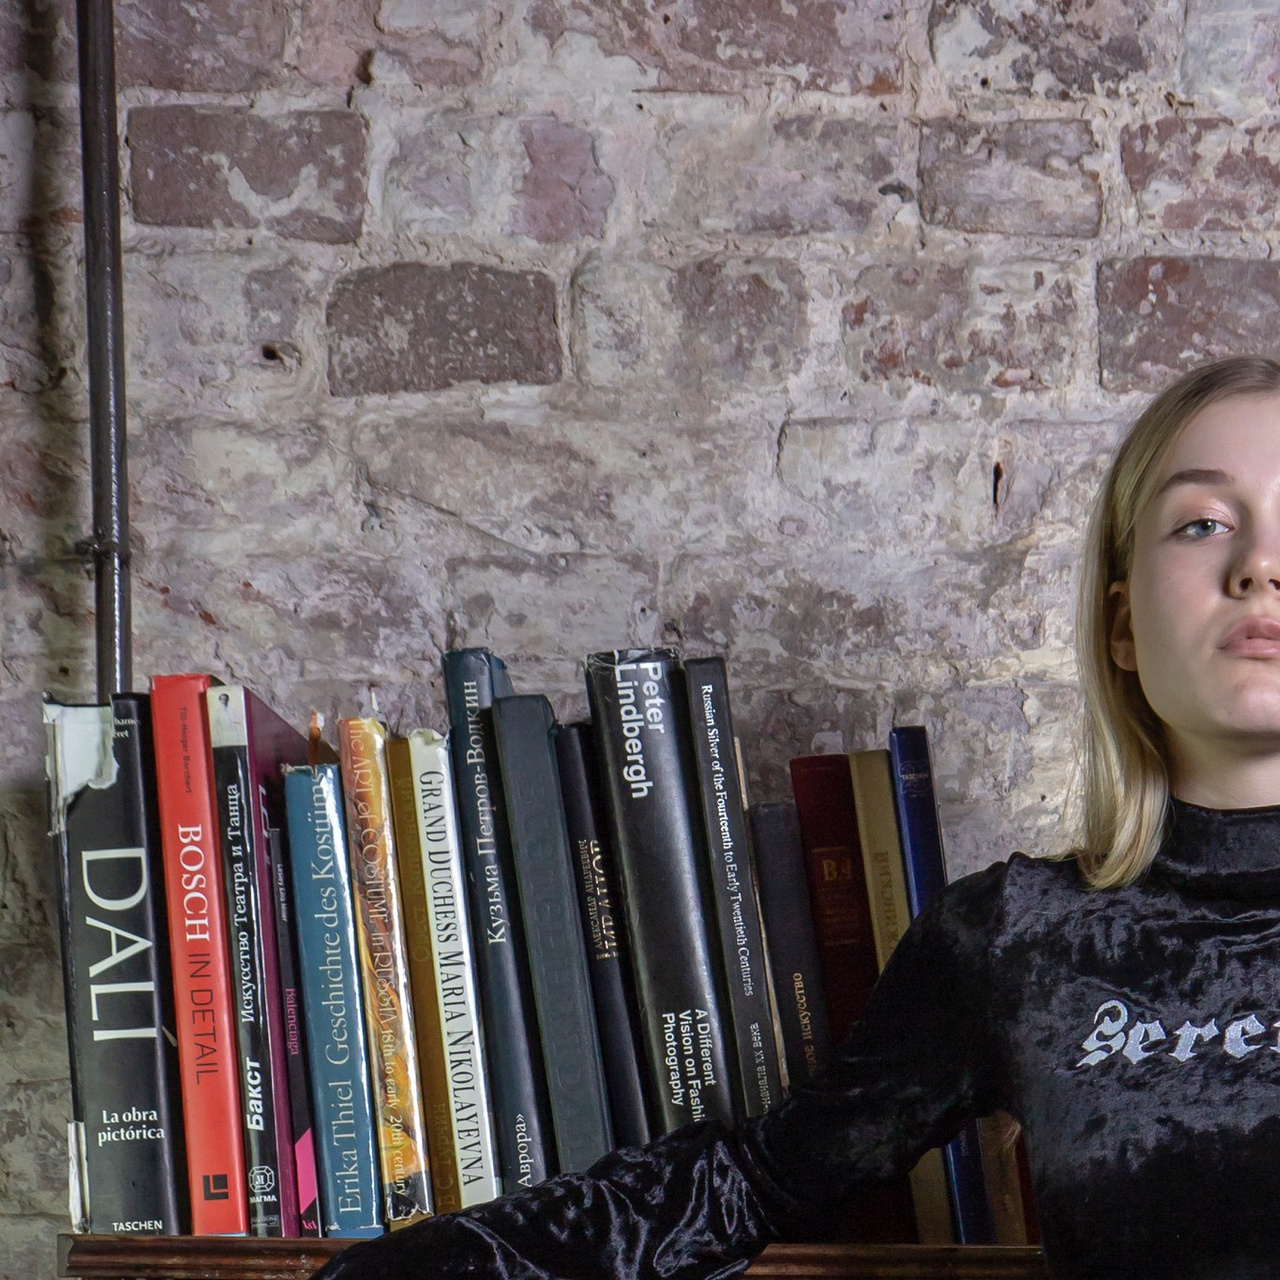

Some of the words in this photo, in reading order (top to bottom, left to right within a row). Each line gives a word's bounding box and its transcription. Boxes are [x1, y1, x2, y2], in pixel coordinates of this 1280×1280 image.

[640, 662, 665, 734] Peter
[701, 684, 715, 726] Russian
[614, 664, 654, 799] Lindbergh
[708, 728, 720, 759] Silver
[353, 756, 374, 793] ART
[464, 681, 496, 856] Петров-Водкин
[711, 761, 724, 772] of
[713, 774, 725, 790] the
[227, 783, 241, 841] Танца
[308, 771, 334, 880] Kostüms
[358, 803, 374, 824] of
[419, 770, 448, 843] GRAND
[716, 791, 733, 850] Fourteenth
[231, 844, 243, 857] и
[361, 828, 388, 923] COSTUME
[724, 852, 733, 862] to
[726, 863, 740, 892] Early
[177, 823, 210, 942] BOSCH
[233, 861, 249, 927] Театра
[315, 889, 338, 929] des
[428, 852, 461, 943] DUCHESS
[486, 863, 507, 946] Кузьма
[372, 932, 383, 947] in
[730, 893, 747, 945] Twentieth
[188, 953, 211, 978] IN
[237, 931, 257, 1023] Искусство
[372, 953, 398, 1024] RUSSIA
[438, 950, 466, 1024] MARIA
[738, 947, 753, 997] Centuries
[285, 988, 299, 1056] Balenciaga
[318, 932, 350, 1066] Geschichte
[695, 1009, 709, 1019] A
[792, 972, 813, 1040] искусство
[190, 989, 219, 1086] DETAIL
[380, 1029, 397, 1057] 18th
[662, 1012, 685, 1106] Photography
[679, 1010, 694, 1055] Vision
[698, 1023, 717, 1086] Different
[246, 1056, 265, 1131] Бакст
[385, 1061, 394, 1075] to
[385, 1075, 399, 1109] early
[685, 1058, 697, 1076] on
[98, 1125, 165, 1147] pictórica
[102, 1110, 119, 1124] La
[122, 1106, 158, 1122] obra
[328, 1079, 356, 1147] Thiel
[389, 1116, 404, 1148] 20th
[447, 1030, 485, 1187] NIKOLAYEVNA
[393, 1154, 405, 1196] century
[515, 1113, 532, 1188] Аврора»
[335, 1148, 361, 1214] Erika
[112, 1219, 163, 1232] TASCHEN
